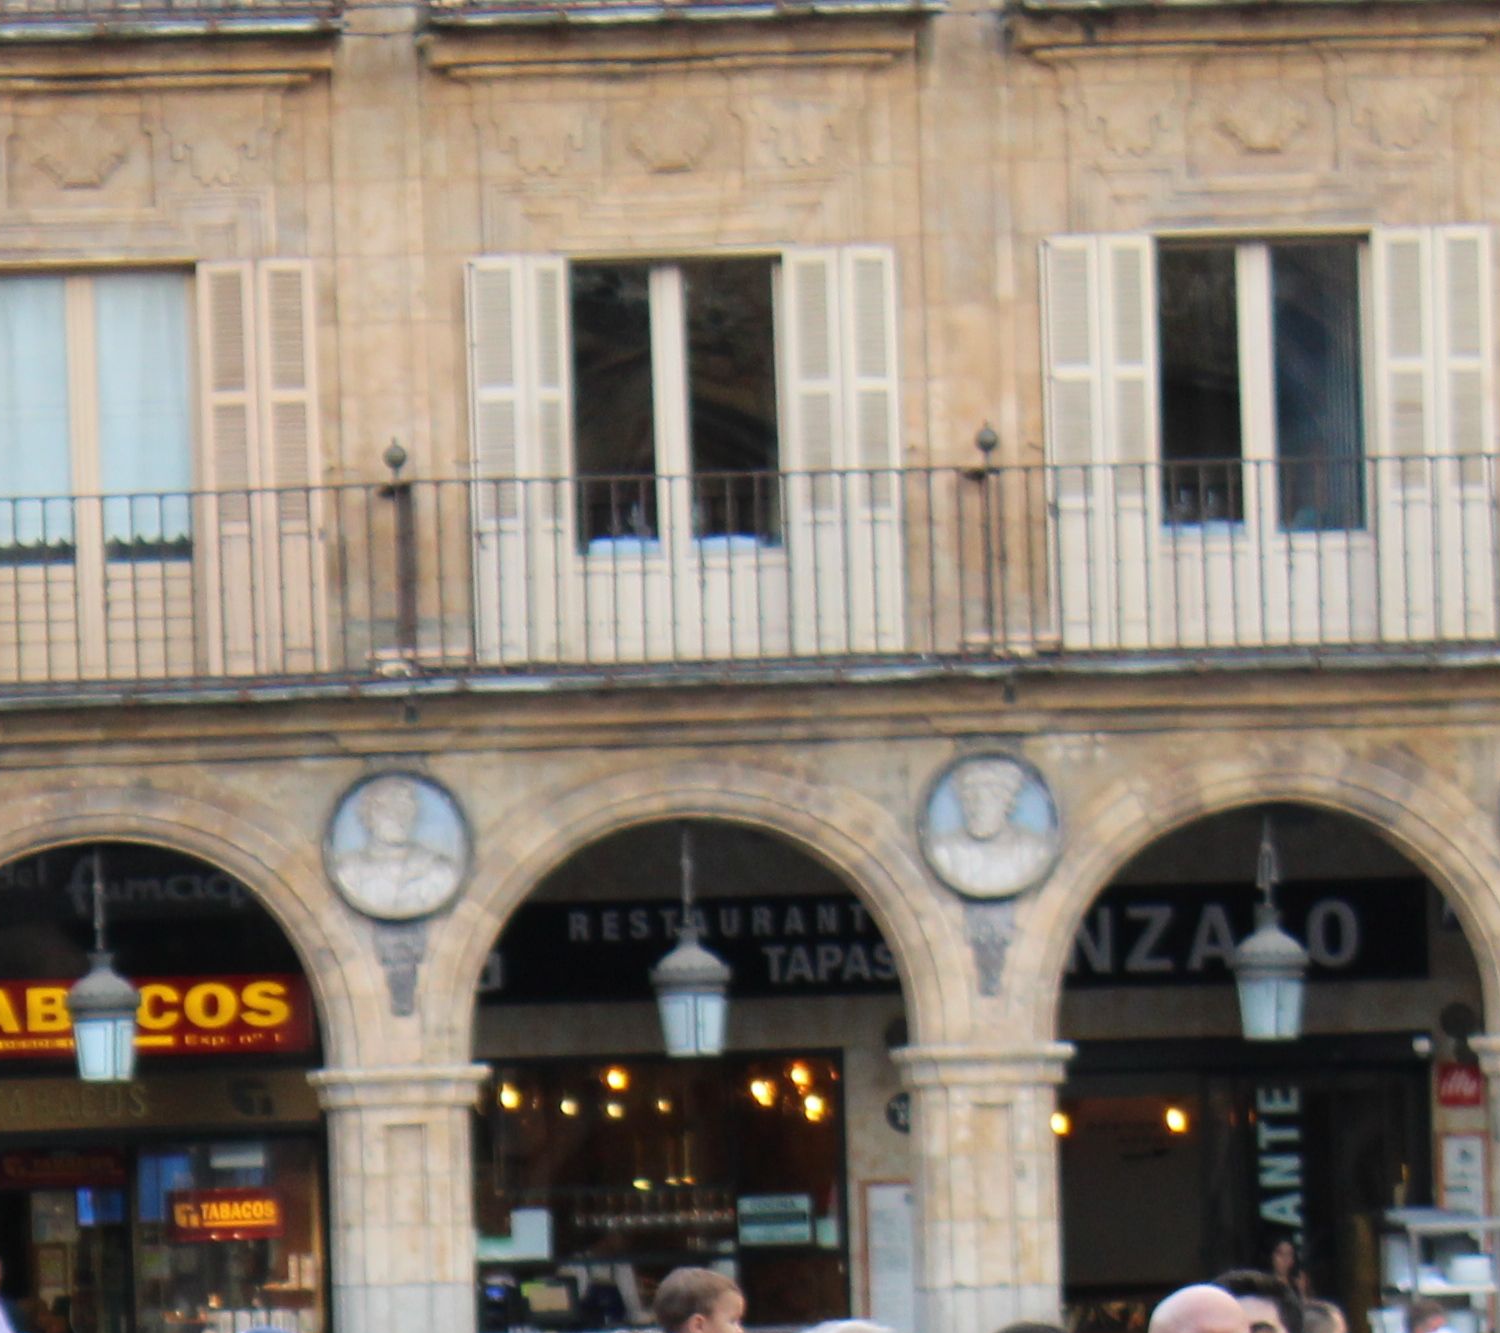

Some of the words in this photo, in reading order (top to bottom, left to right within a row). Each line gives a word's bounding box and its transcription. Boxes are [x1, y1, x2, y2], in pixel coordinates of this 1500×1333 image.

[1068, 900, 1360, 973] NZAO
[762, 944, 899, 982] TAPAS
[201, 1199, 278, 1221] TABACOS
